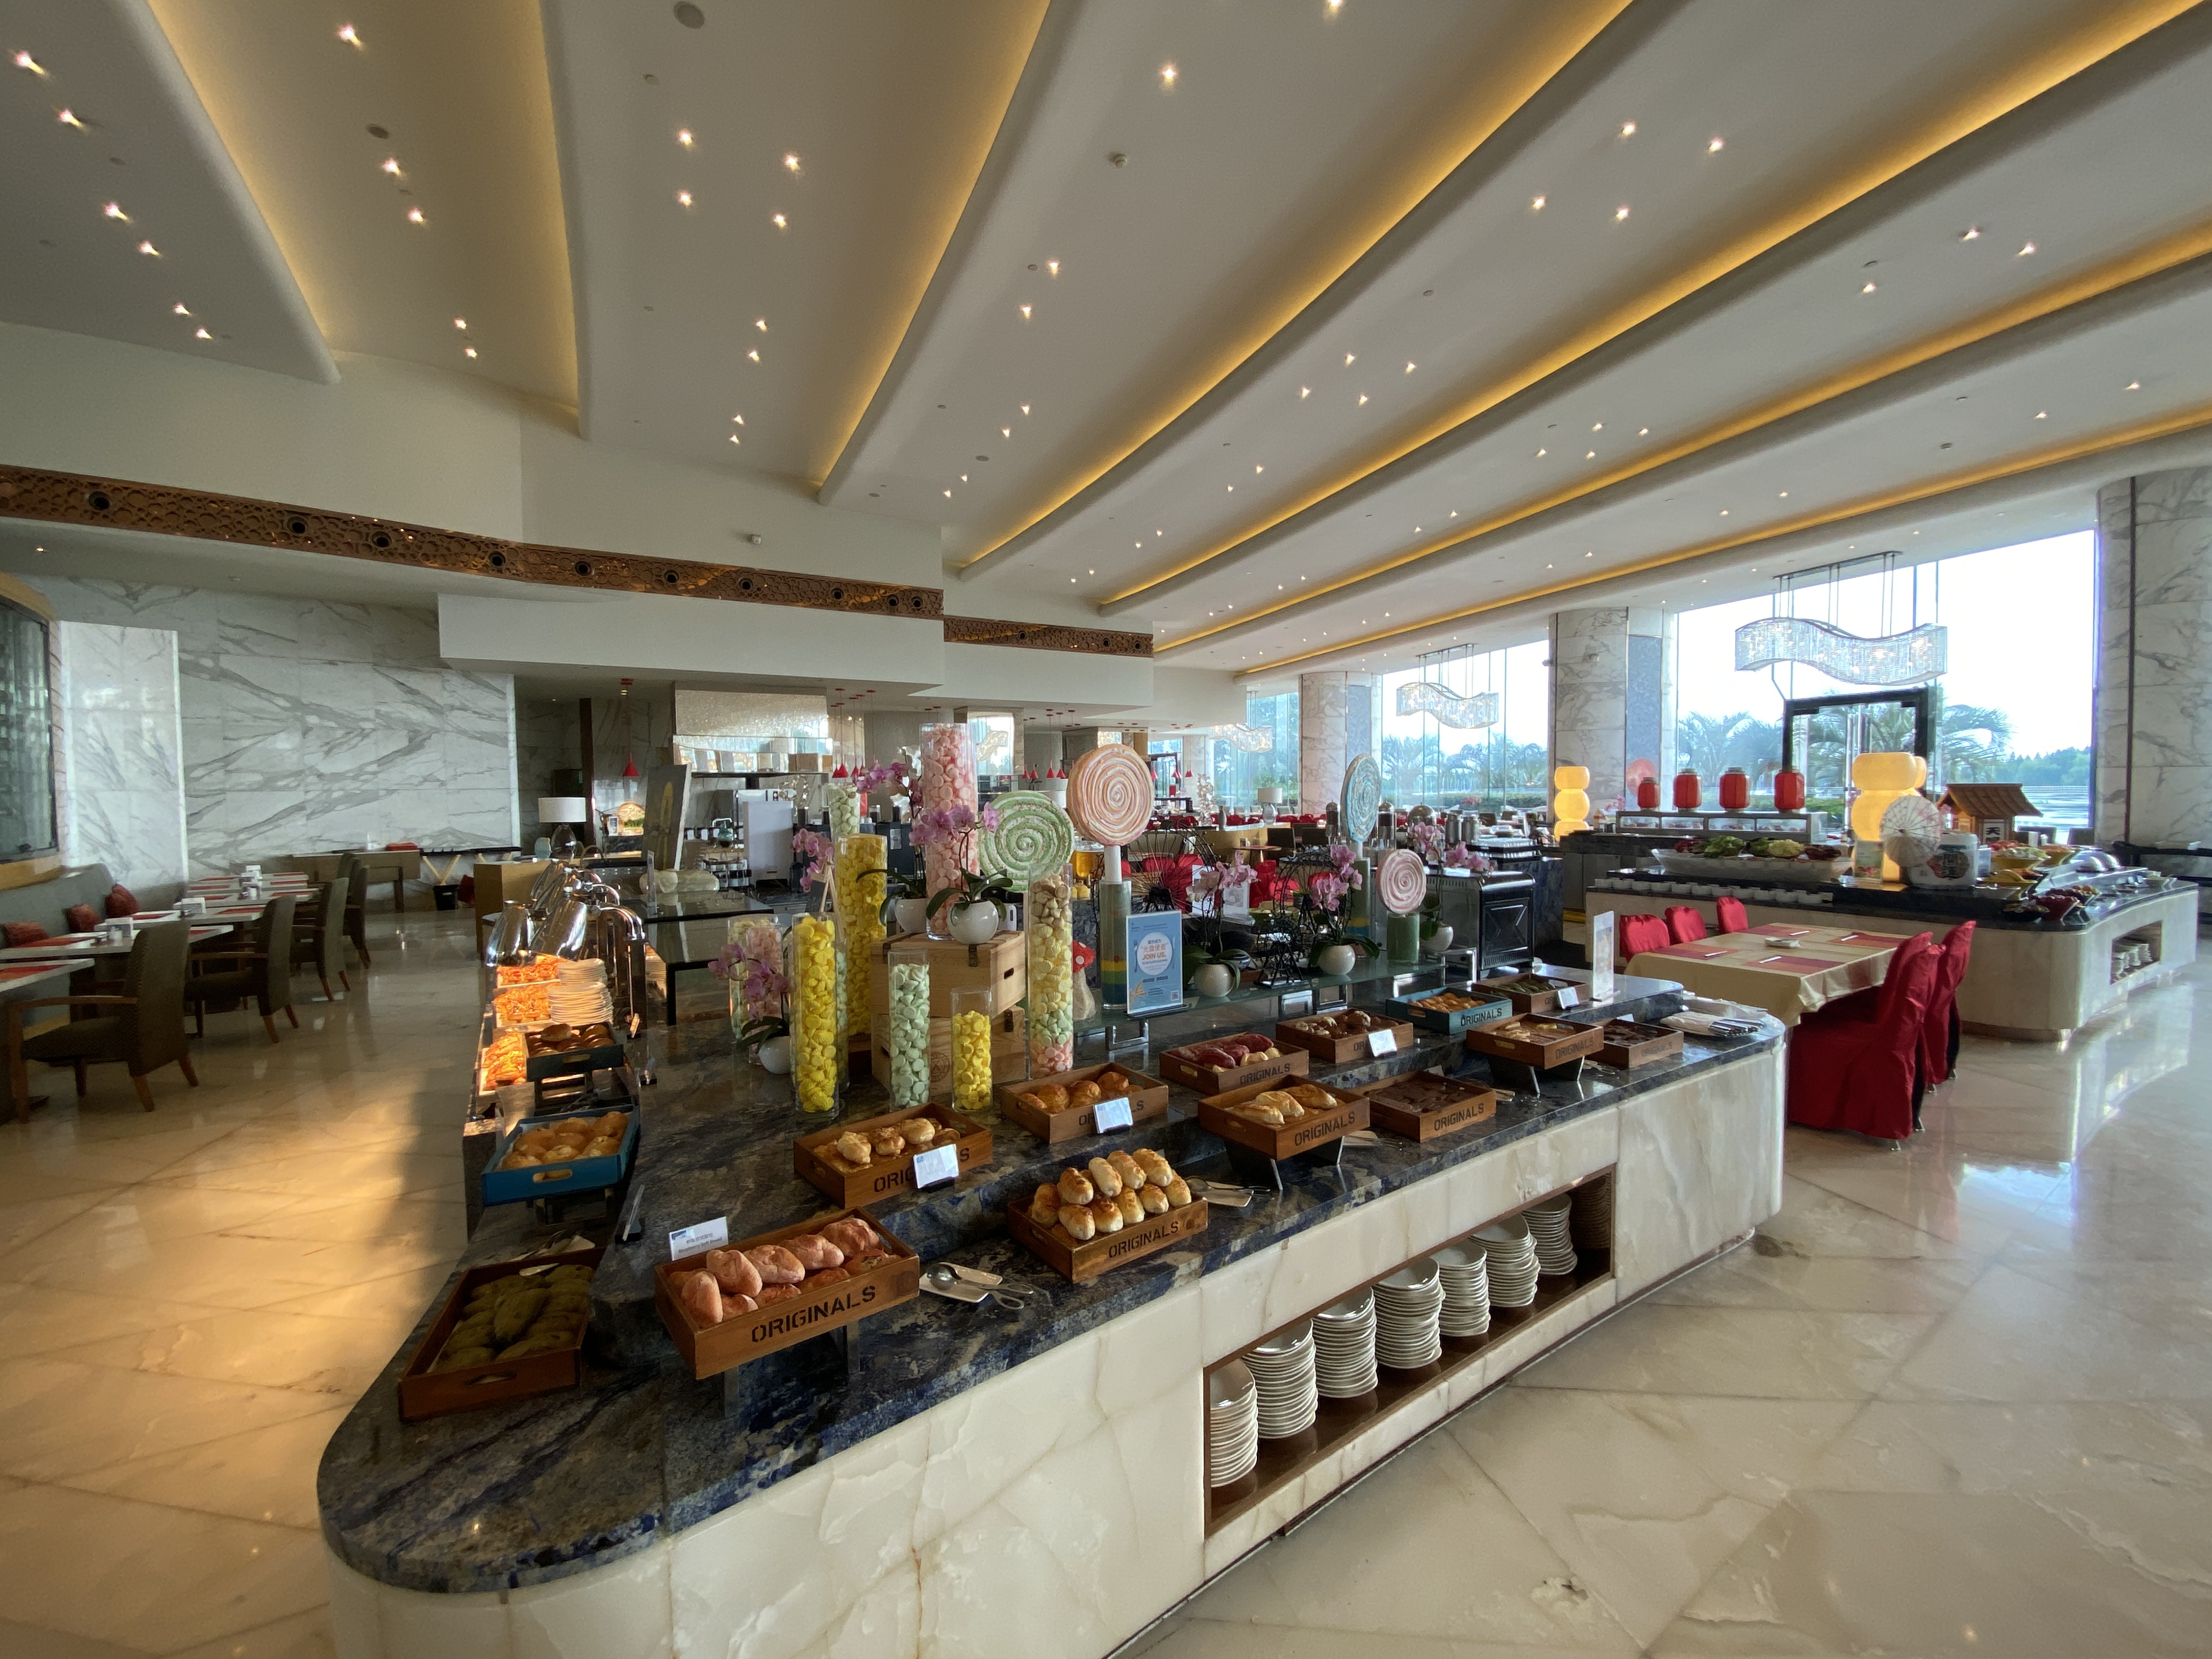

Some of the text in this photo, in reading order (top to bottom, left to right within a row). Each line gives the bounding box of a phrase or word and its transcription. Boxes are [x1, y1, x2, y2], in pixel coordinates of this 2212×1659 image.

[1460, 1008, 1502, 1026] ORIGINALS
[1555, 1036, 1595, 1059] ORIGINALS
[1240, 1063, 1290, 1084] ORIGINALS
[1294, 1110, 1355, 1146] ORIGINALS
[1434, 1102, 1484, 1131] ORIGINALS
[1109, 1221, 1179, 1258] ORIGINALS
[752, 1285, 876, 1343] ORIGINALS
